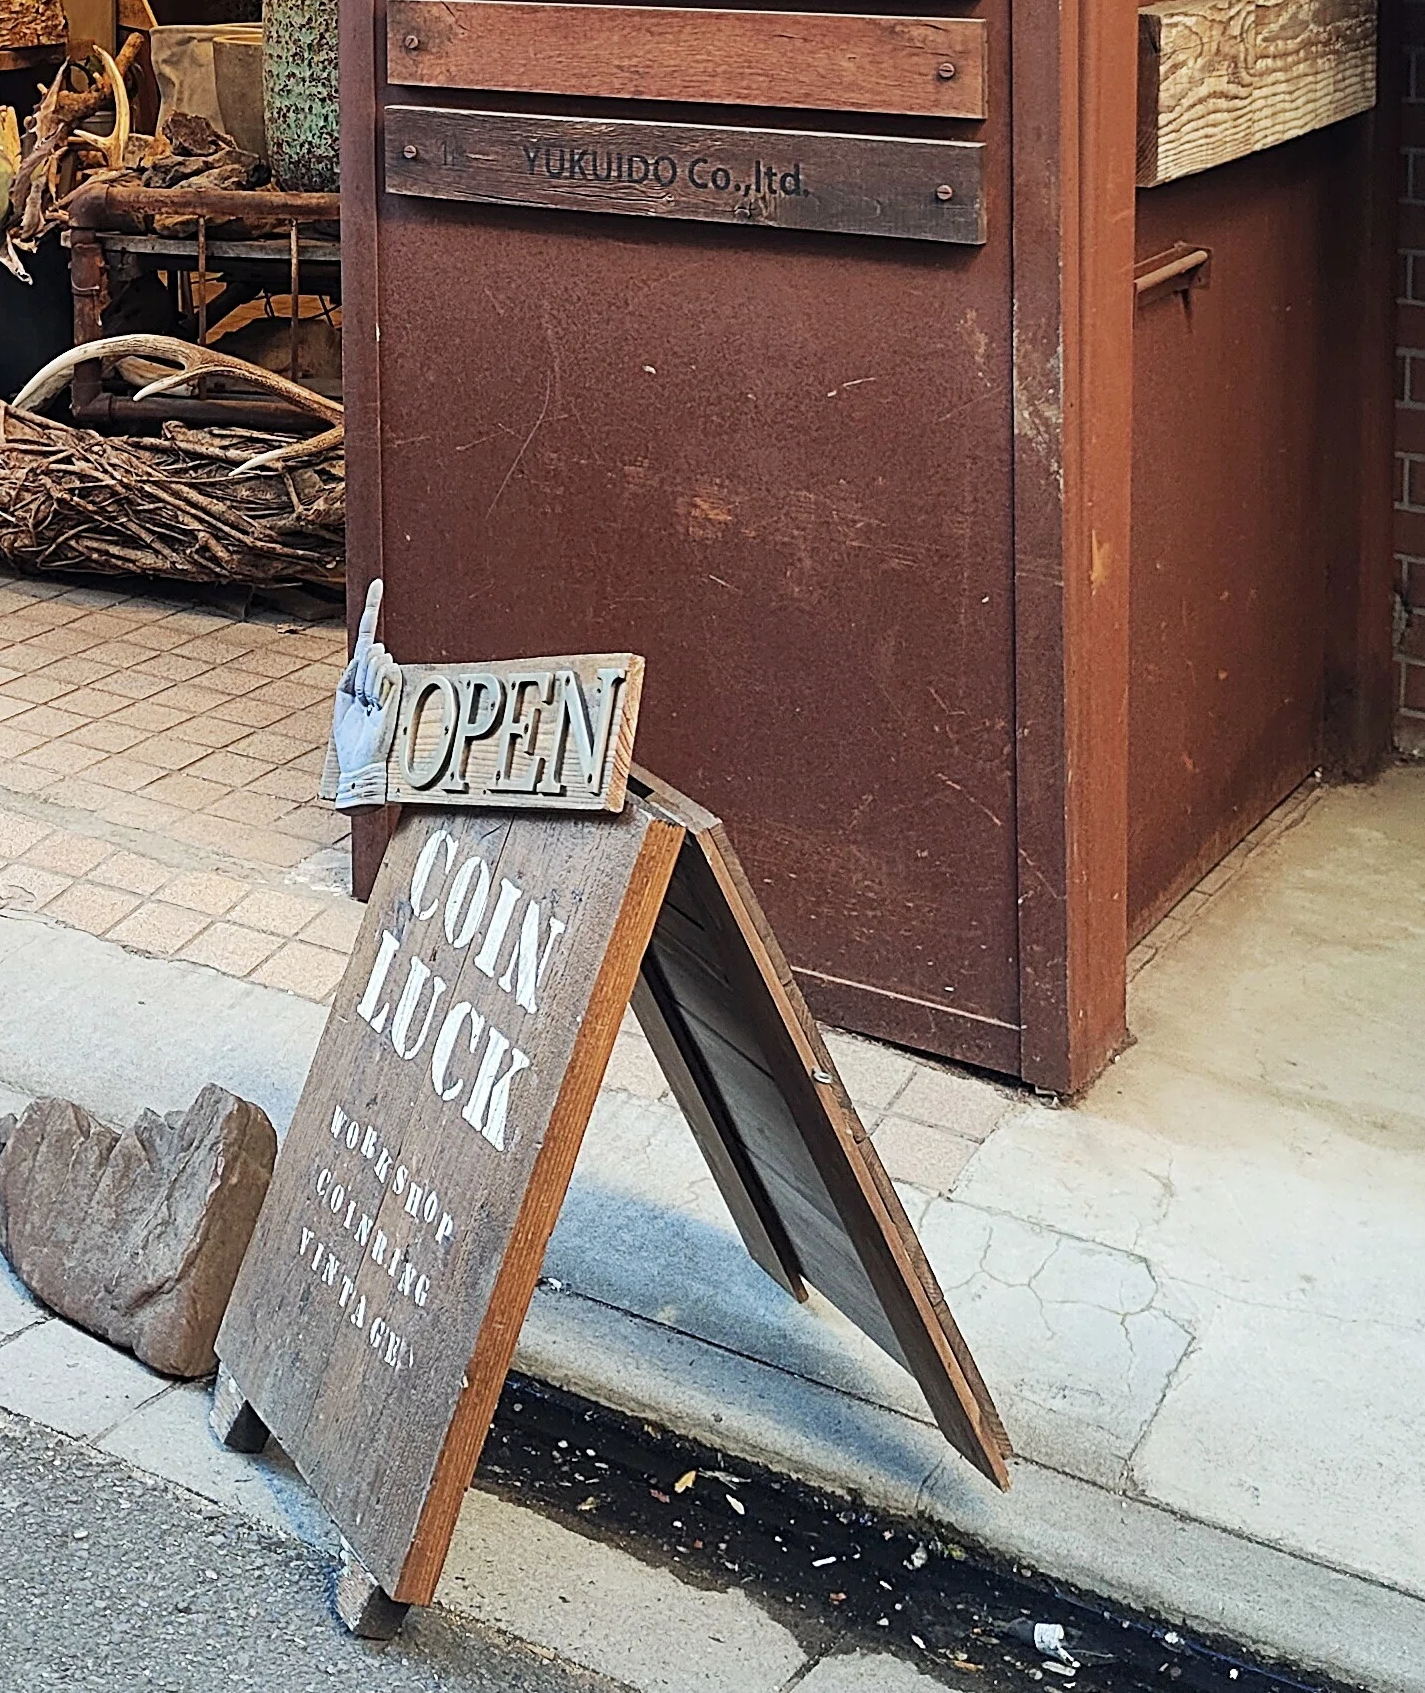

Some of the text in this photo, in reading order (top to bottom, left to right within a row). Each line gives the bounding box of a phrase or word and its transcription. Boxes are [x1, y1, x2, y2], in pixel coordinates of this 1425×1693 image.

[522, 144, 677, 187] YUKUIDO
[399, 668, 626, 796] OPEN
[411, 829, 565, 1015] COIN
[357, 929, 530, 1153] LUCK
